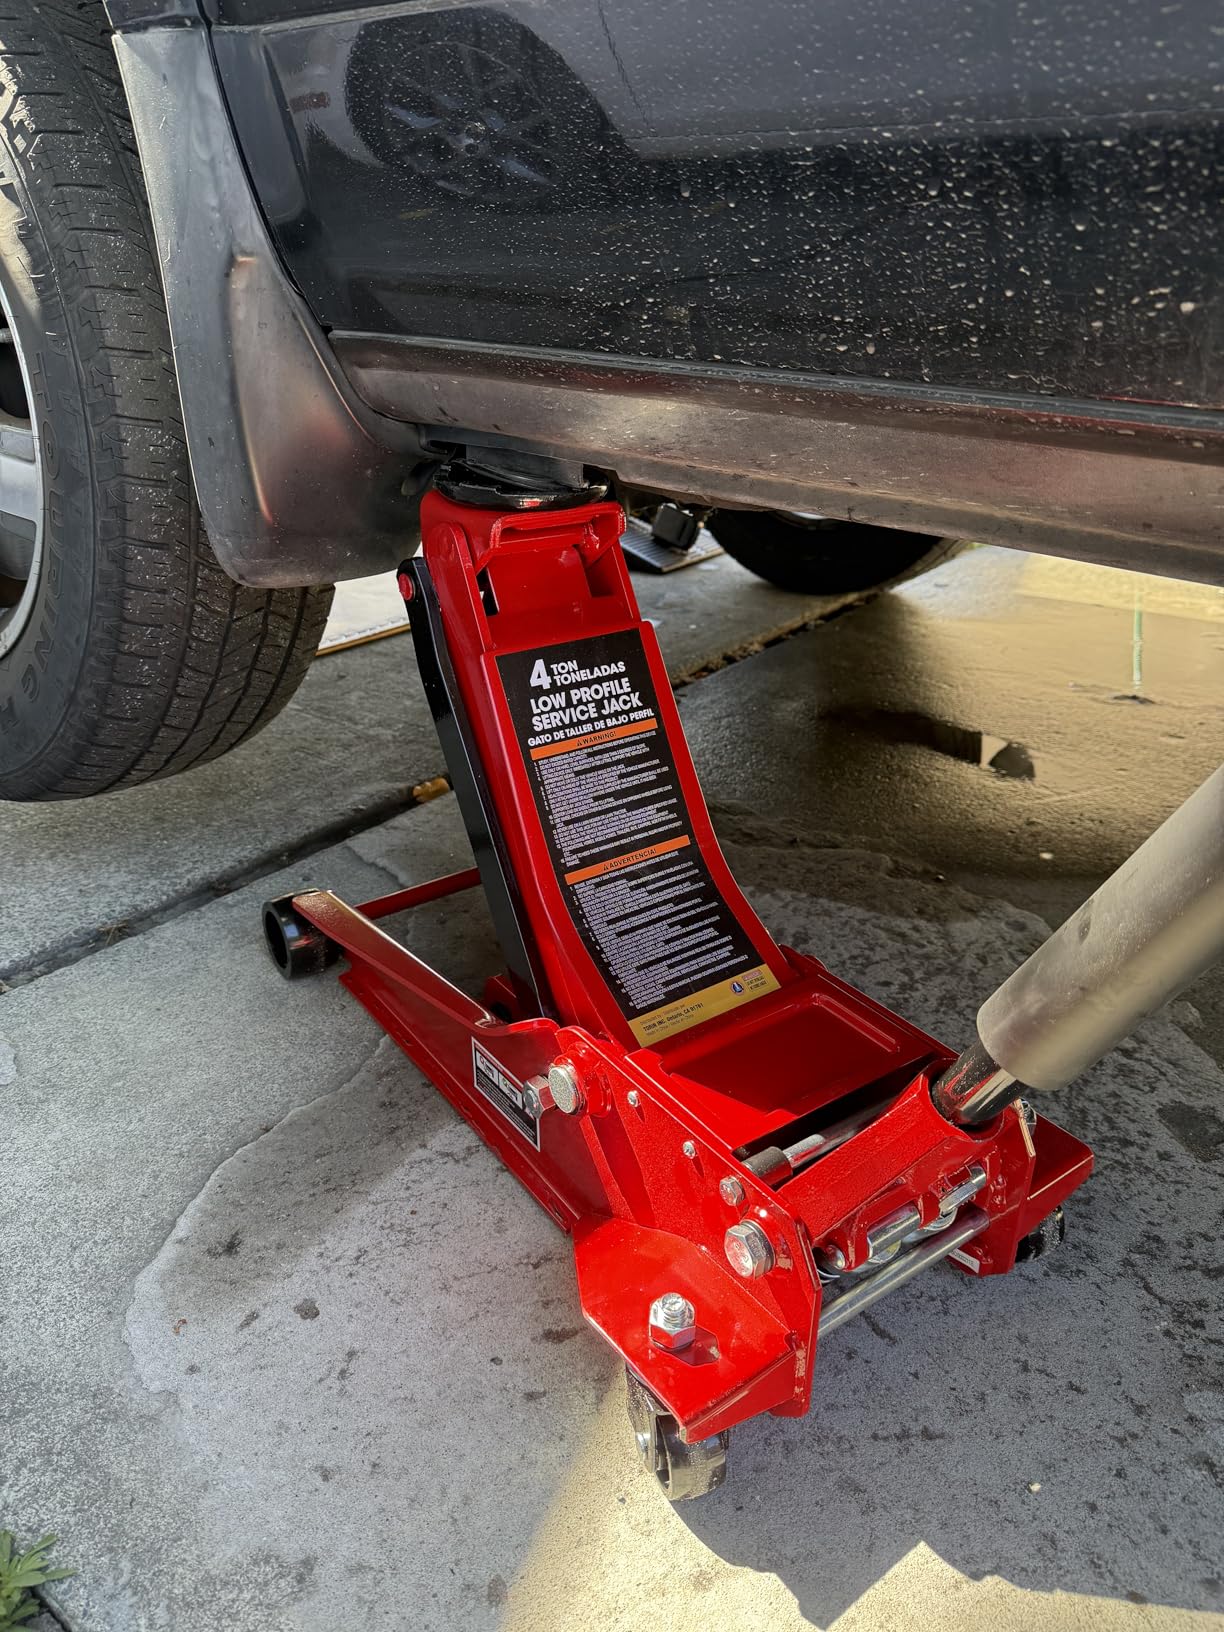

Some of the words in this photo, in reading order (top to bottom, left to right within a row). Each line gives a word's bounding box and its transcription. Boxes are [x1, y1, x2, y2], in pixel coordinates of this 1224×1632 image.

[21, 350, 65, 702] TOURING
[529, 658, 552, 690] 4
[550, 659, 579, 676] TON
[553, 661, 626, 687] TONELADAS
[530, 692, 566, 715] LOW
[569, 677, 632, 705] PROFILE
[531, 702, 599, 732] SERVICE
[600, 691, 643, 716] JACK
[527, 732, 553, 747] GATO
[553, 730, 566, 741] DE
[564, 723, 594, 738] TALLER
[594, 721, 606, 731] DE
[605, 715, 629, 727] BAJO
[629, 707, 655, 722] PERFIL
[581, 731, 617, 746] WARNING!
[608, 848, 657, 869] ADVERTENCIA!
[683, 1006, 691, 1014] CA
